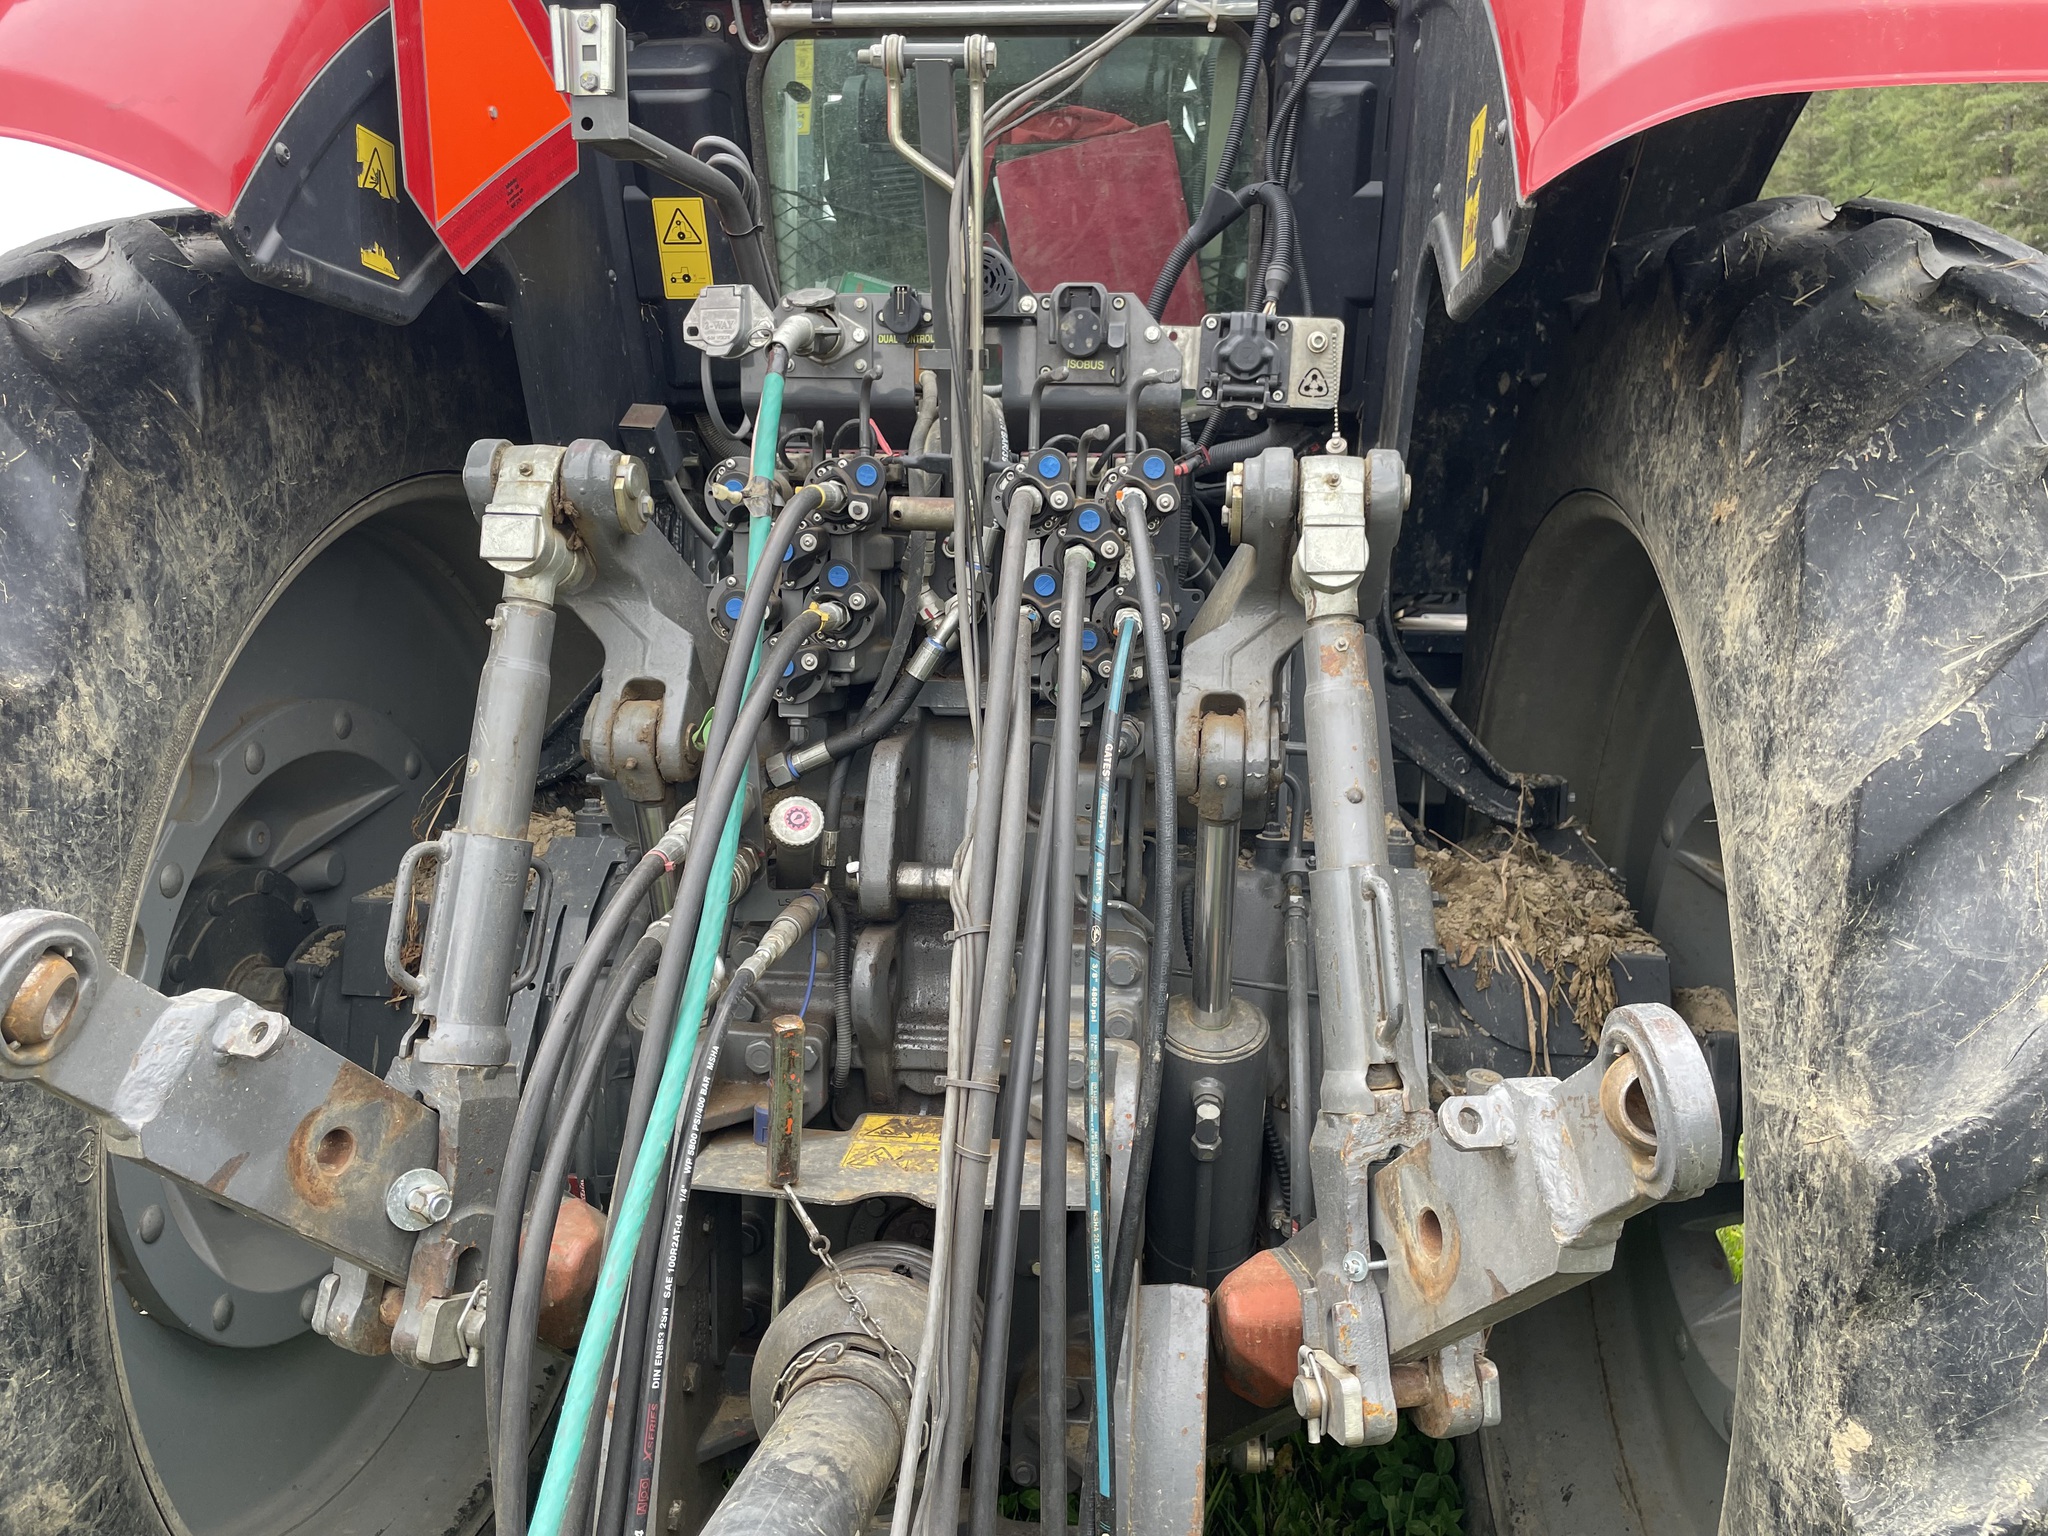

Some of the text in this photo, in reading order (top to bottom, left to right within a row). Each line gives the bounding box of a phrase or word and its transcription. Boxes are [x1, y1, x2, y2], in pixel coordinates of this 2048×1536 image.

[704, 319, 735, 331] 2-WAY
[878, 334, 935, 344] DUAL NTROL
[1067, 359, 1104, 370] ISOBUS
[777, 898, 791, 906] LS
[1090, 1009, 1098, 1022] psi
[706, 1045, 720, 1071] MSHA
[699, 1076, 711, 1096] BAR
[691, 1097, 707, 1131] PSI/400
[687, 1132, 699, 1156] 5800
[683, 1158, 694, 1174] WP
[678, 1184, 688, 1202] 1/4"
[667, 1214, 684, 1273] 100R2AT-04
[663, 1277, 674, 1299] SAE
[659, 1307, 669, 1329] 2SN
[654, 1332, 665, 1366] EN853
[651, 1369, 662, 1389] DIN
